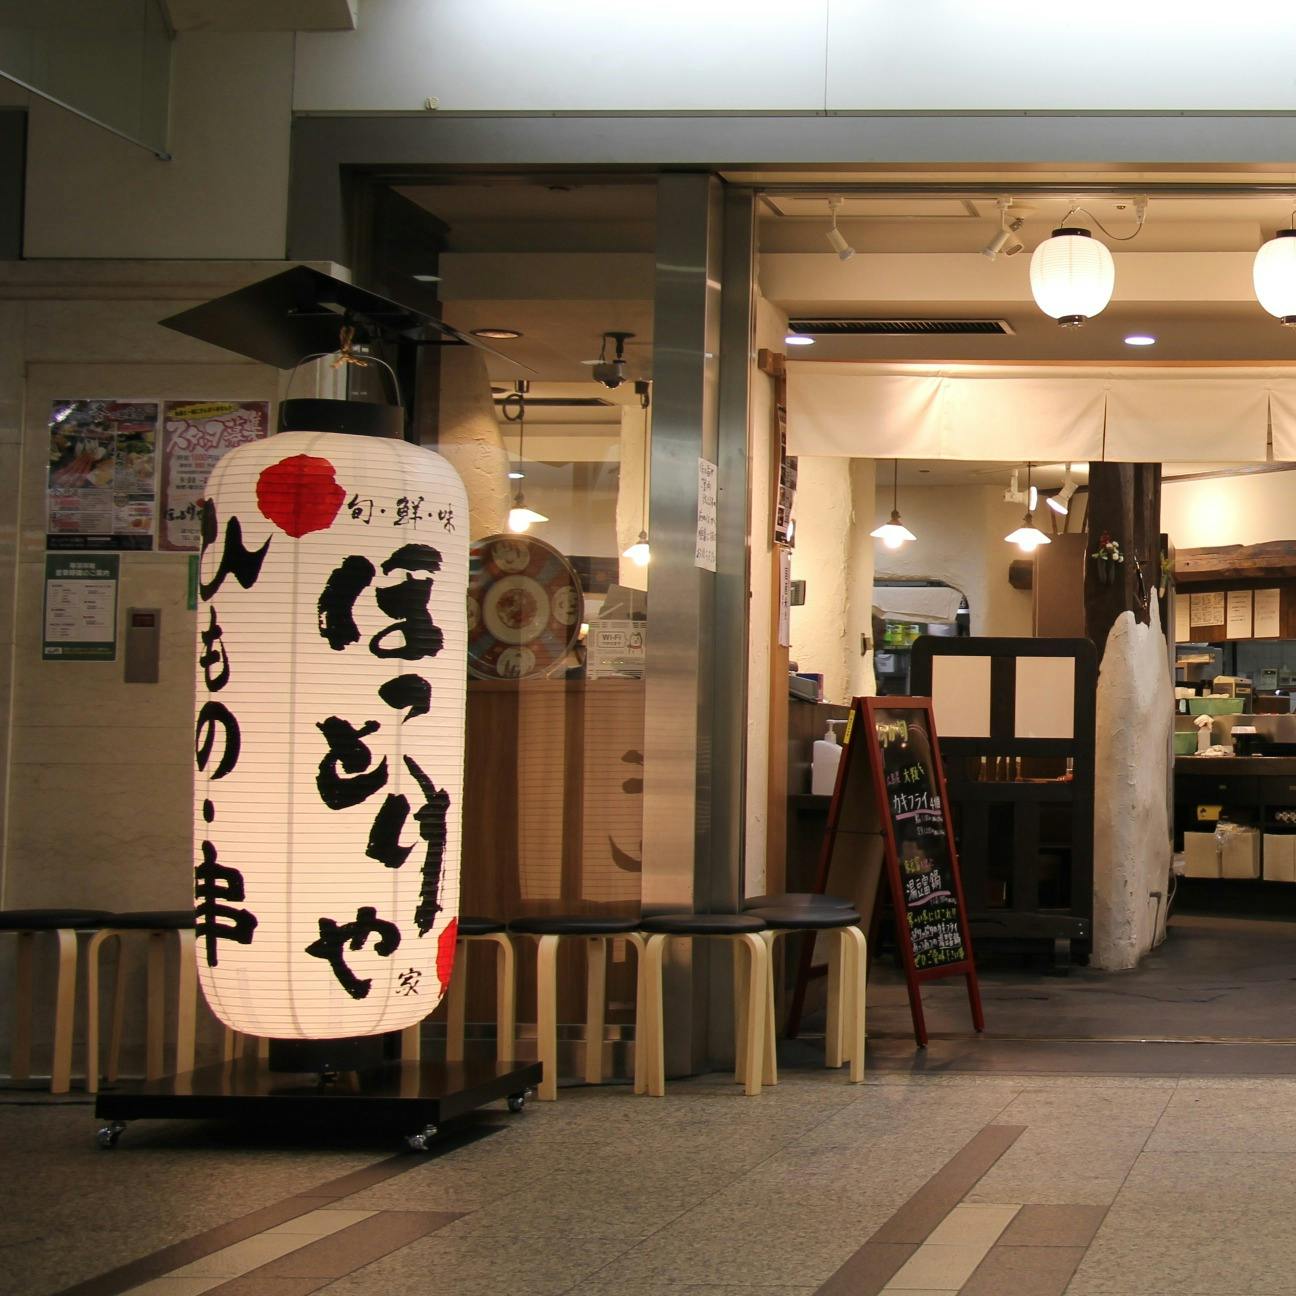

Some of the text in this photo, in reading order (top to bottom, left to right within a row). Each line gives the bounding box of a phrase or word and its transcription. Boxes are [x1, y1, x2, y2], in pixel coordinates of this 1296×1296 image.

[893, 791, 928, 813] カキフライ
[395, 967, 422, 996] 家
